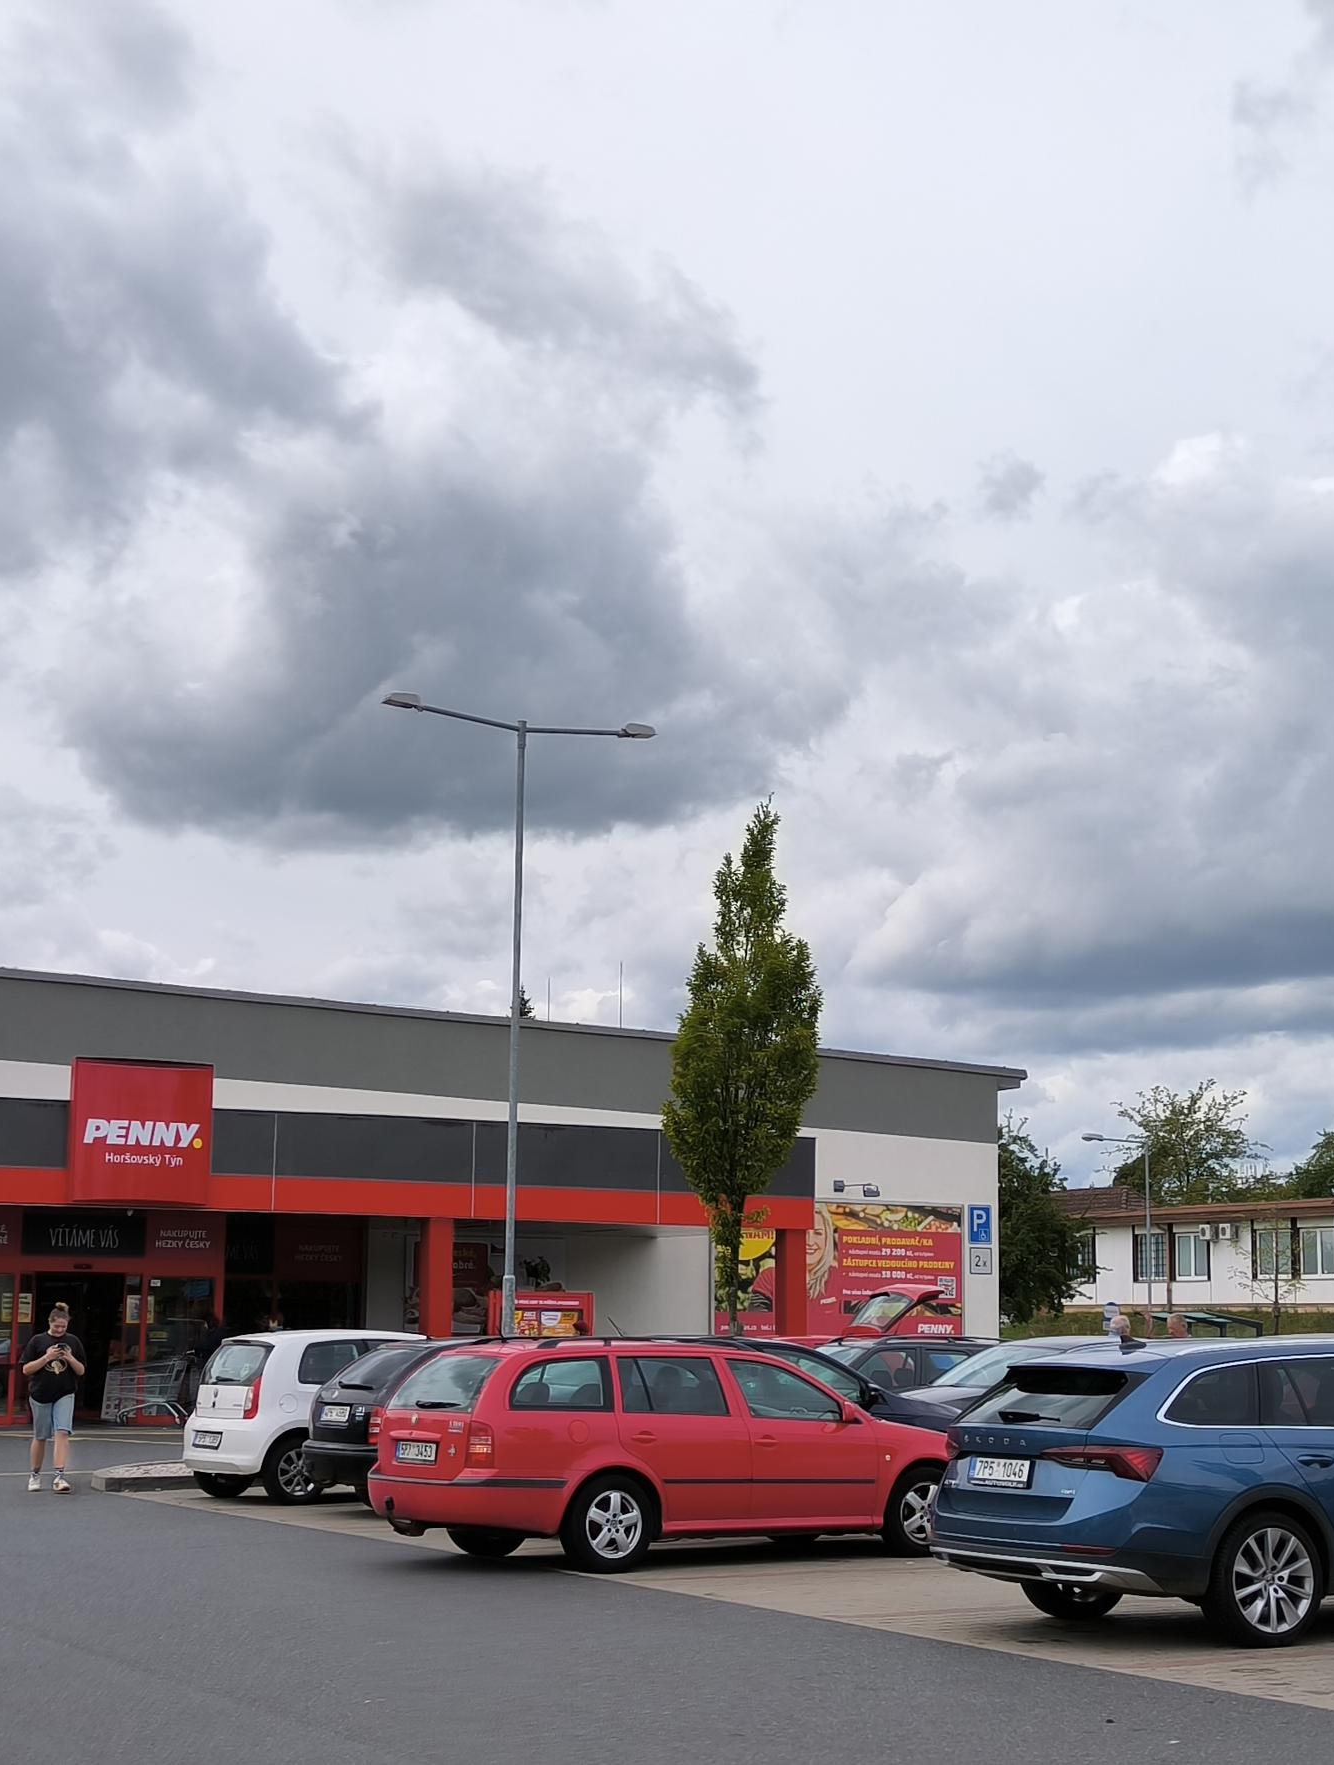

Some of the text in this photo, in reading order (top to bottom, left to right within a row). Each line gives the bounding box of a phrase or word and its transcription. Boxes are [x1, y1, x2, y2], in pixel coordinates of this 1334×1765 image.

[105, 1152, 183, 1168] Horšovský Týn
[973, 1209, 987, 1232] P
[49, 1224, 120, 1249] VÍTÁME VÁS
[160, 1229, 207, 1239] NAKUPUJTE
[155, 1238, 211, 1249] HEZKY ČESKY
[843, 1235, 933, 1247] POKLADNÍ, PRODAVAČ/KA
[882, 1248, 891, 1256] 29
[892, 1248, 906, 1256] 200
[843, 1256, 877, 1267] ZÁSTUPCE
[892, 1270, 906, 1279] 000
[976, 1459, 1025, 1479] 7P5 1046
